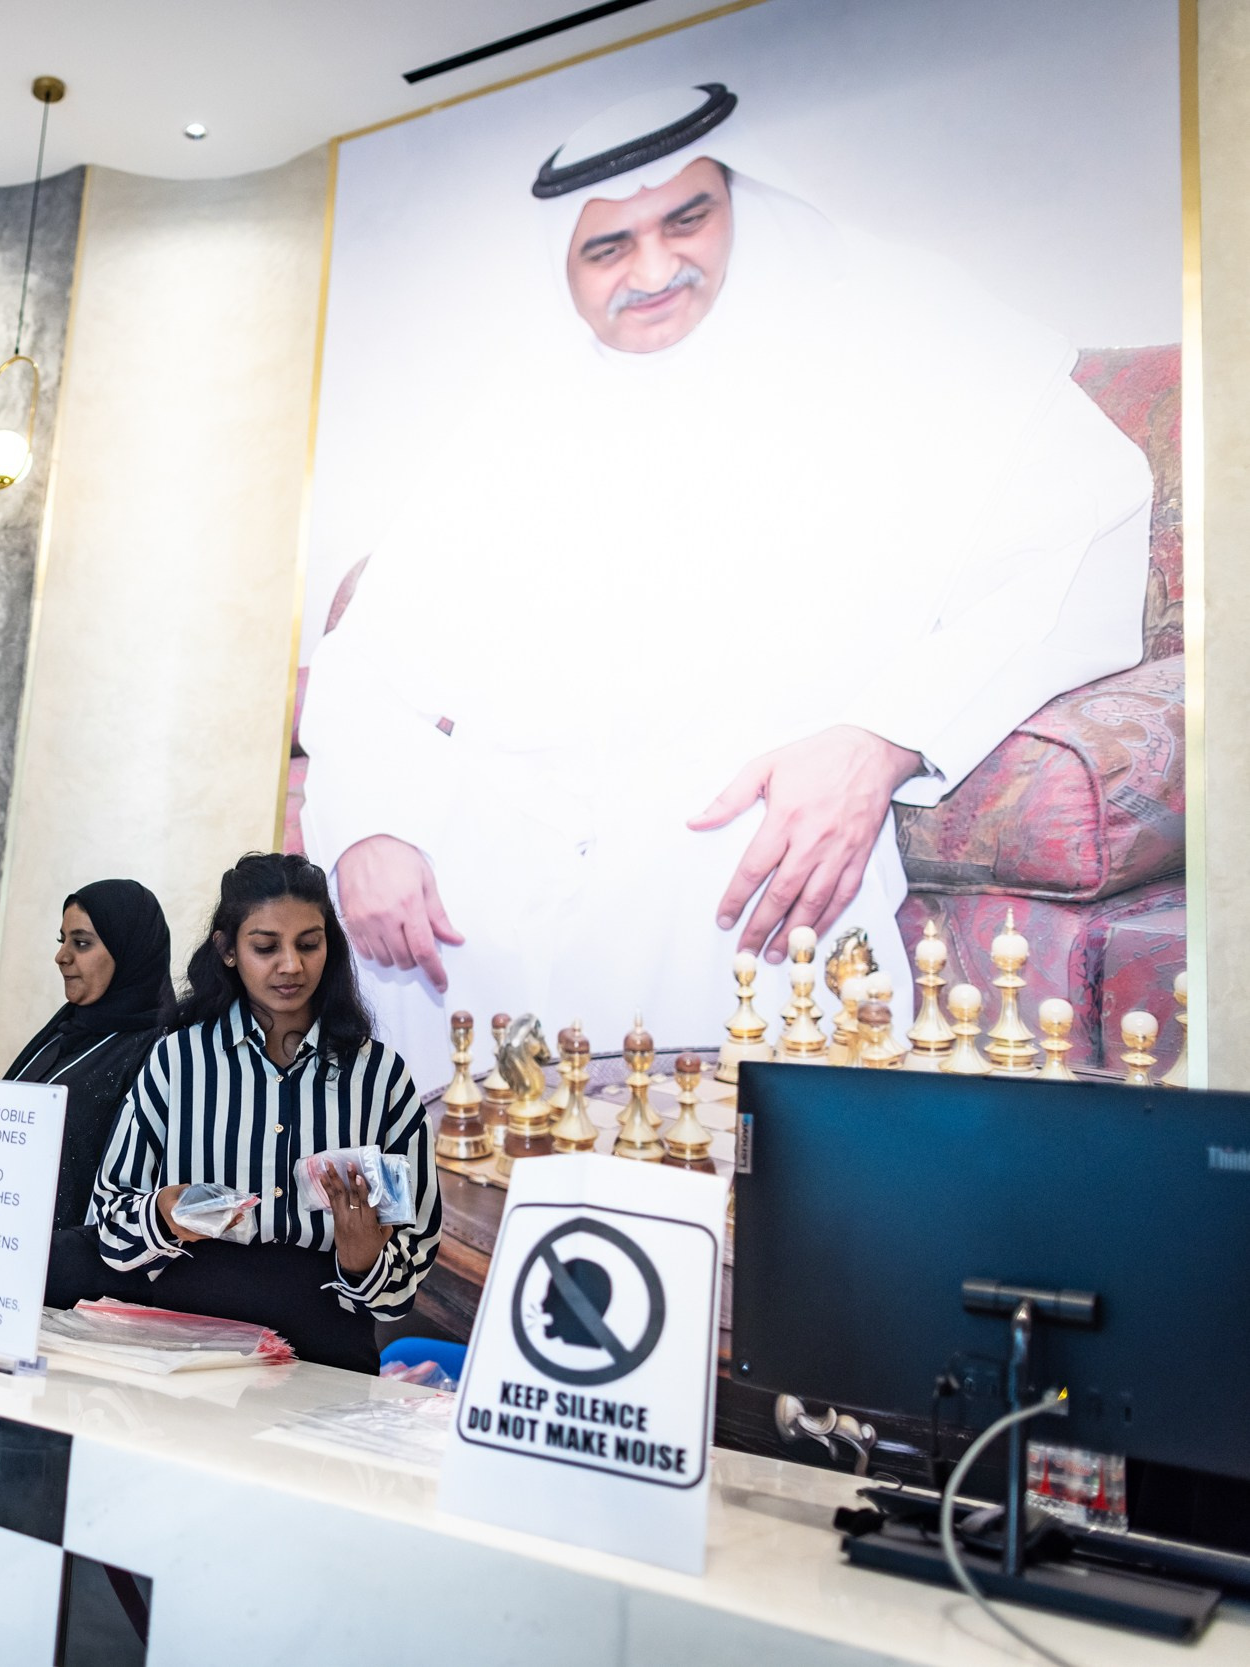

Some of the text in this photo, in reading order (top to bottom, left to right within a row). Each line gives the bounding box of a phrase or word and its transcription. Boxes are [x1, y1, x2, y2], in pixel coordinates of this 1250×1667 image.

[500, 1381, 648, 1432] KEEP SILENCE
[467, 1406, 687, 1474] DO NOT MAKE NOISE
